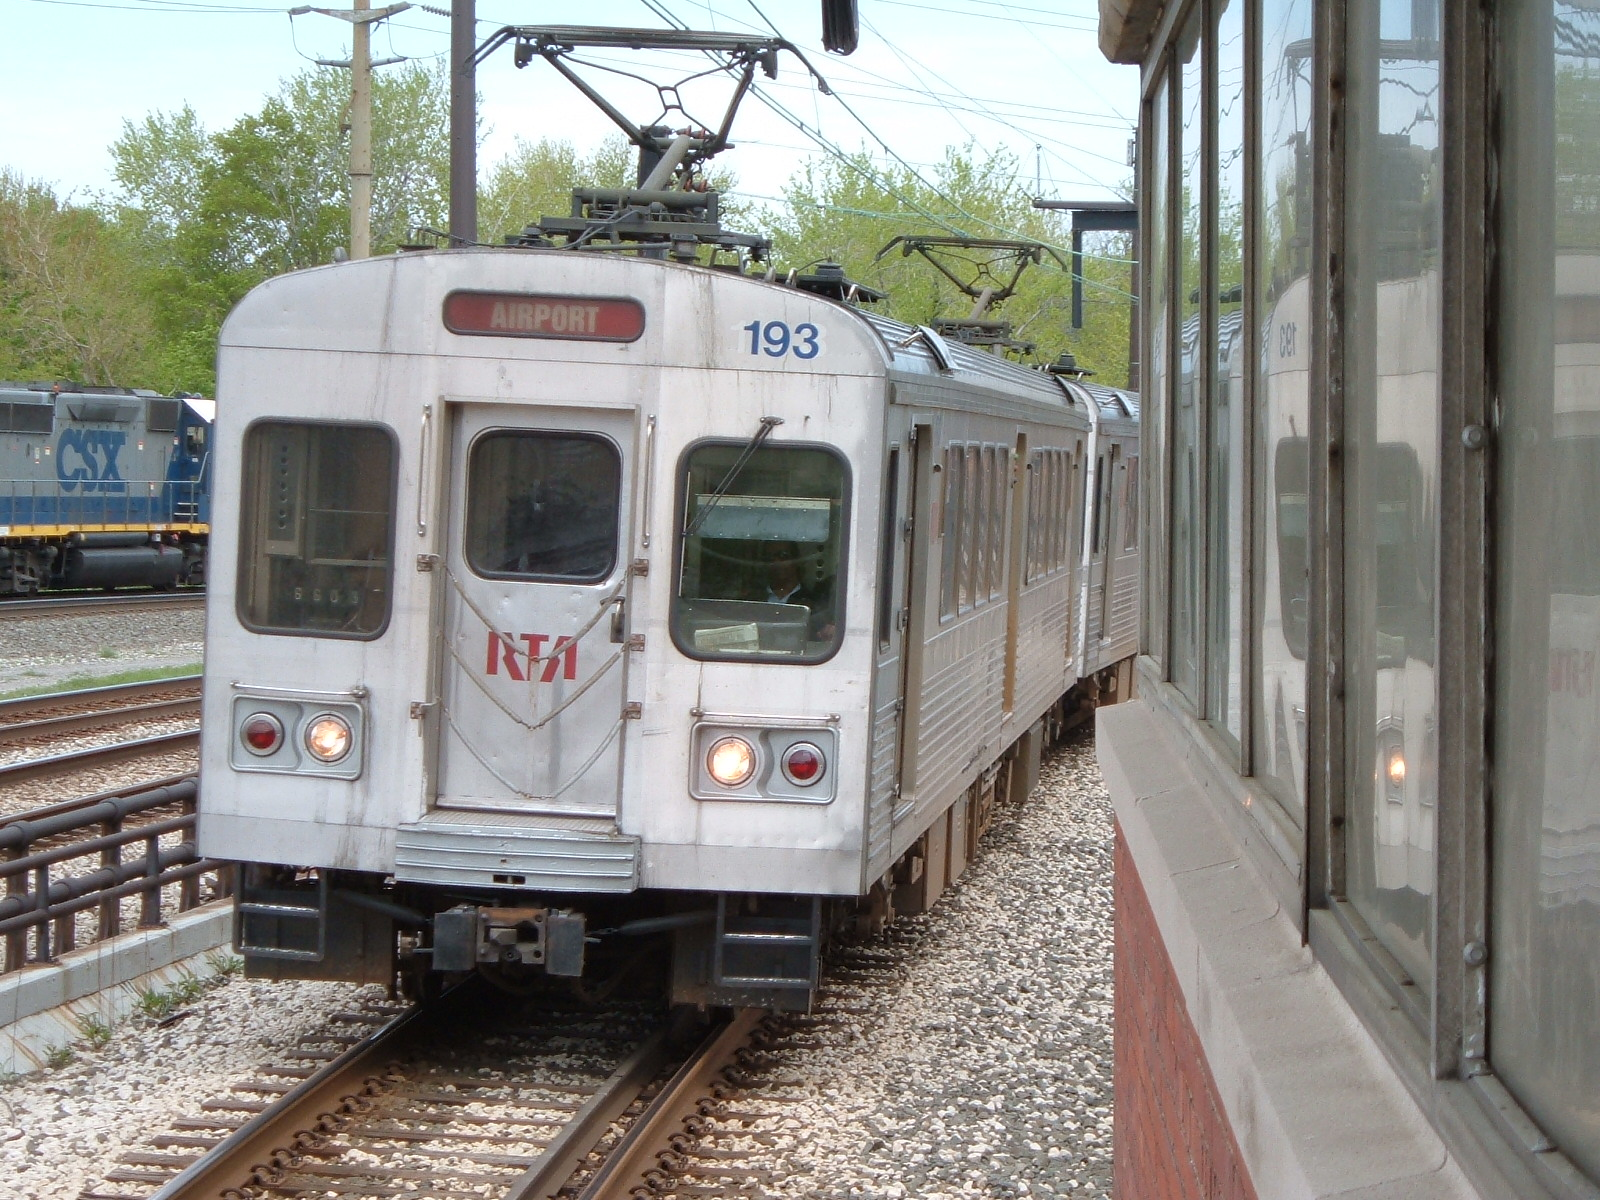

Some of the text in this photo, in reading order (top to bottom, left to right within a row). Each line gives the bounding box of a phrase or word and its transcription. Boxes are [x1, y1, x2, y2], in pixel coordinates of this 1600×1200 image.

[490, 302, 599, 333] AIRPORT
[743, 320, 819, 359] 193
[56, 428, 126, 492] CSX
[486, 631, 578, 682] RTA
